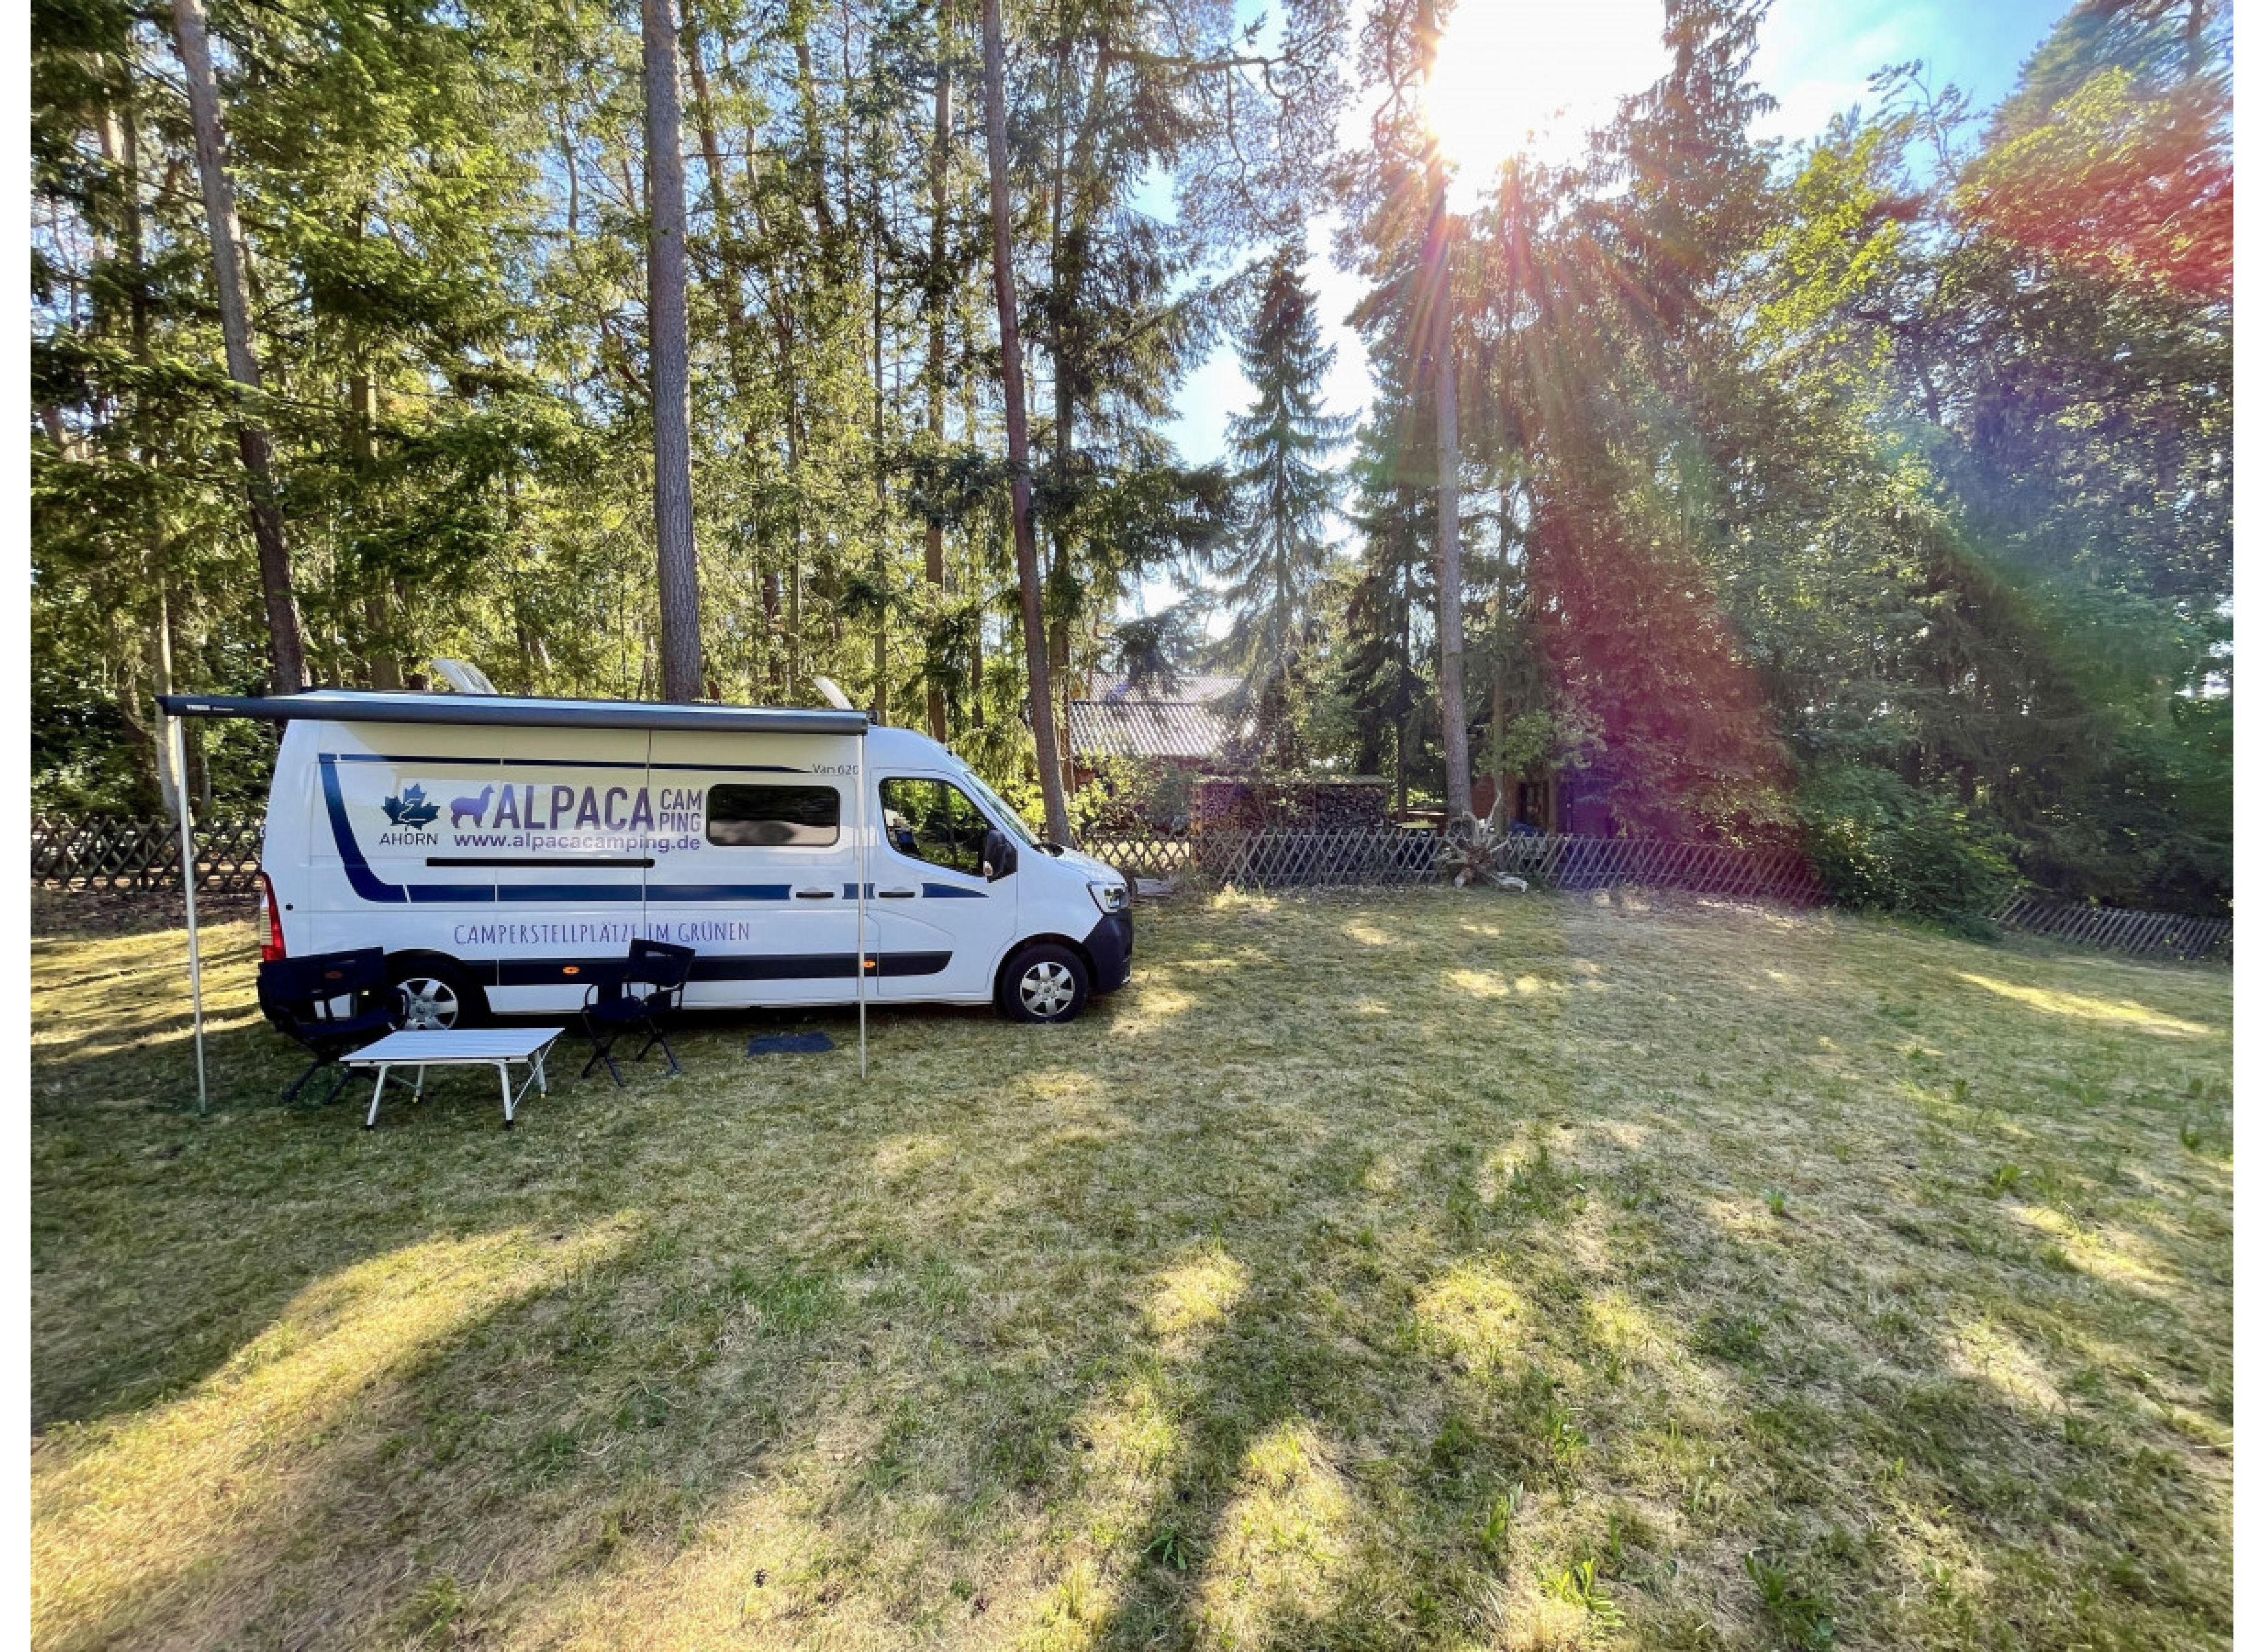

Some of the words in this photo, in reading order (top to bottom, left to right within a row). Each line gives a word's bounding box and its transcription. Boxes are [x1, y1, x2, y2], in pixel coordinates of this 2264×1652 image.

[812, 763, 835, 774] Van
[493, 783, 655, 830] ALPACA
[660, 789, 703, 810] CAM
[660, 813, 701, 832] PING
[379, 833, 439, 845] AHORN
[454, 831, 701, 854] www.alpacacamping.de
[647, 923, 670, 942] IM
[678, 921, 750, 942] GRÜNEN
